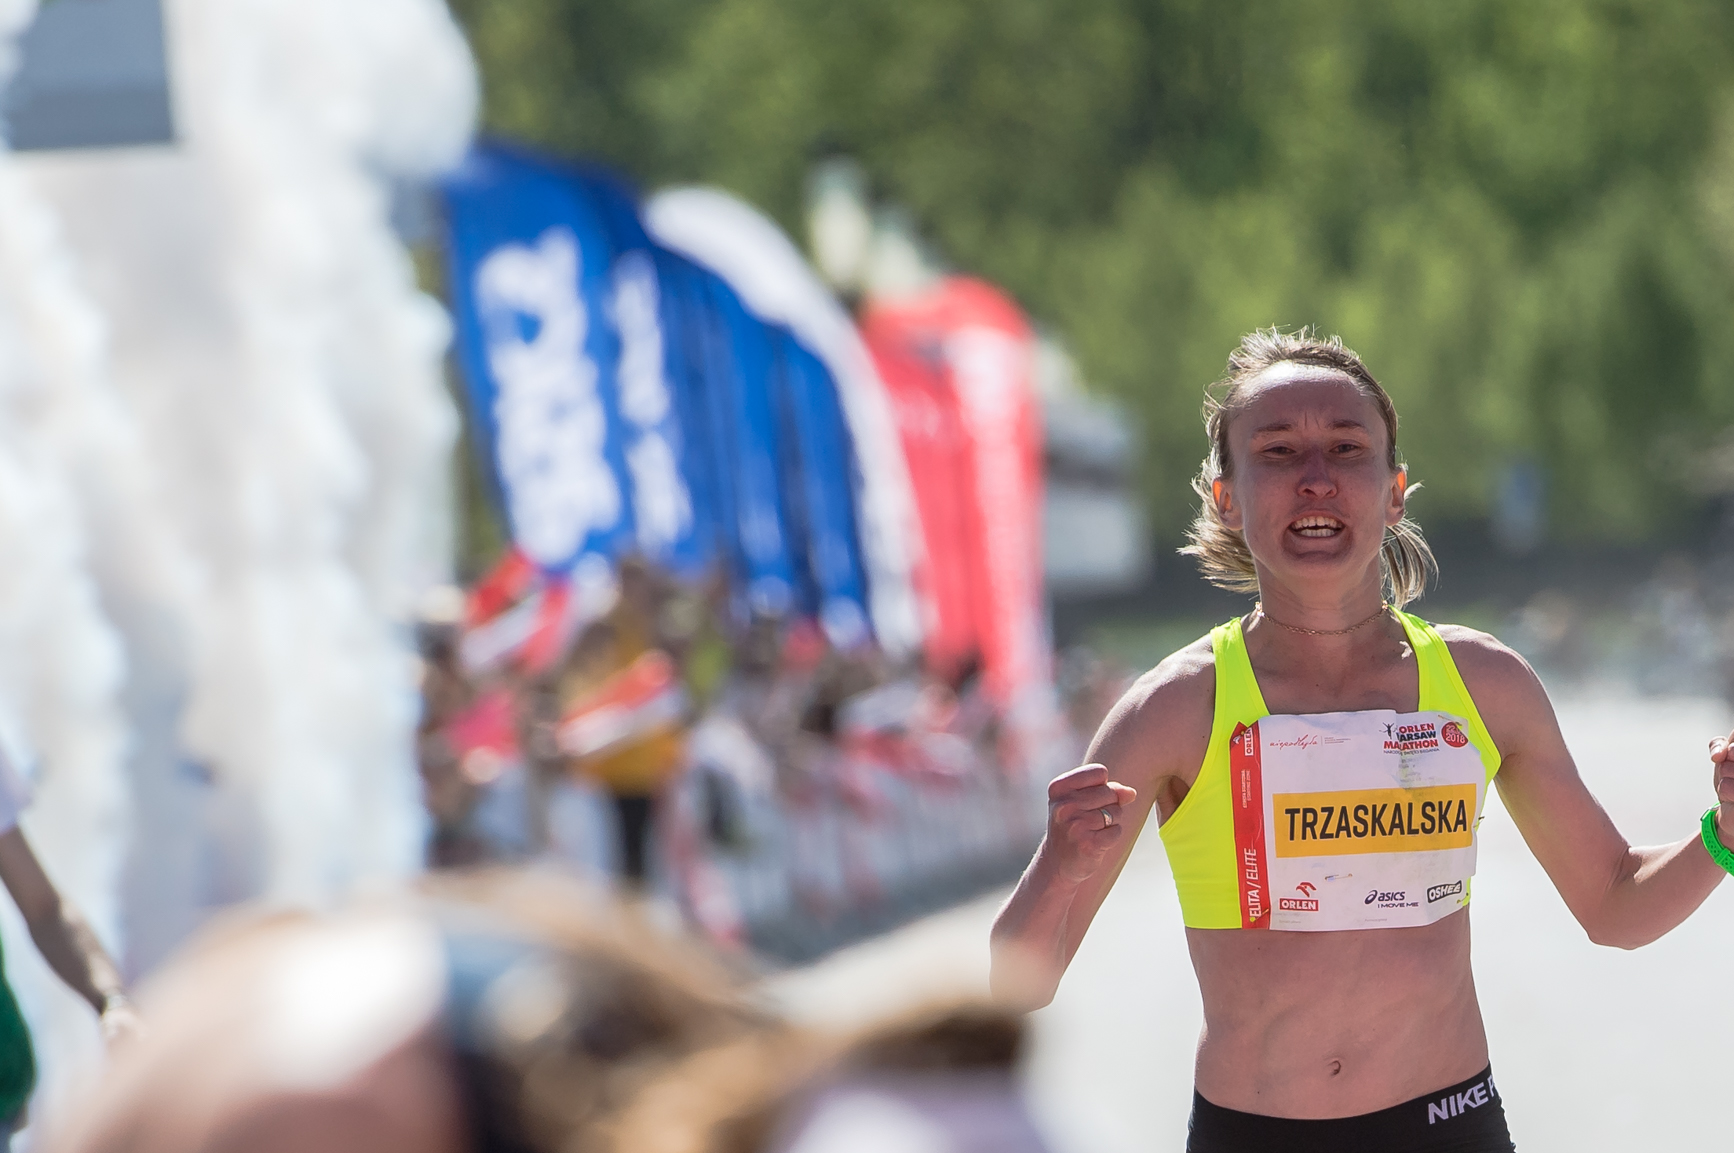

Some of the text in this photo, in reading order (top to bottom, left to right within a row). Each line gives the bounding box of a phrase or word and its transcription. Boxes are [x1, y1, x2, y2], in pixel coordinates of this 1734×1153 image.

[1399, 723, 1435, 734] ORLEN
[1384, 739, 1439, 750] MAATHON
[1445, 733, 1466, 744] 2018
[1285, 799, 1467, 841] TRZASKALSKA
[1243, 847, 1259, 880] ELITE
[1247, 889, 1262, 917] ELITA
[1281, 899, 1316, 910] ORLEN
[1428, 1082, 1489, 1125] NIKE
